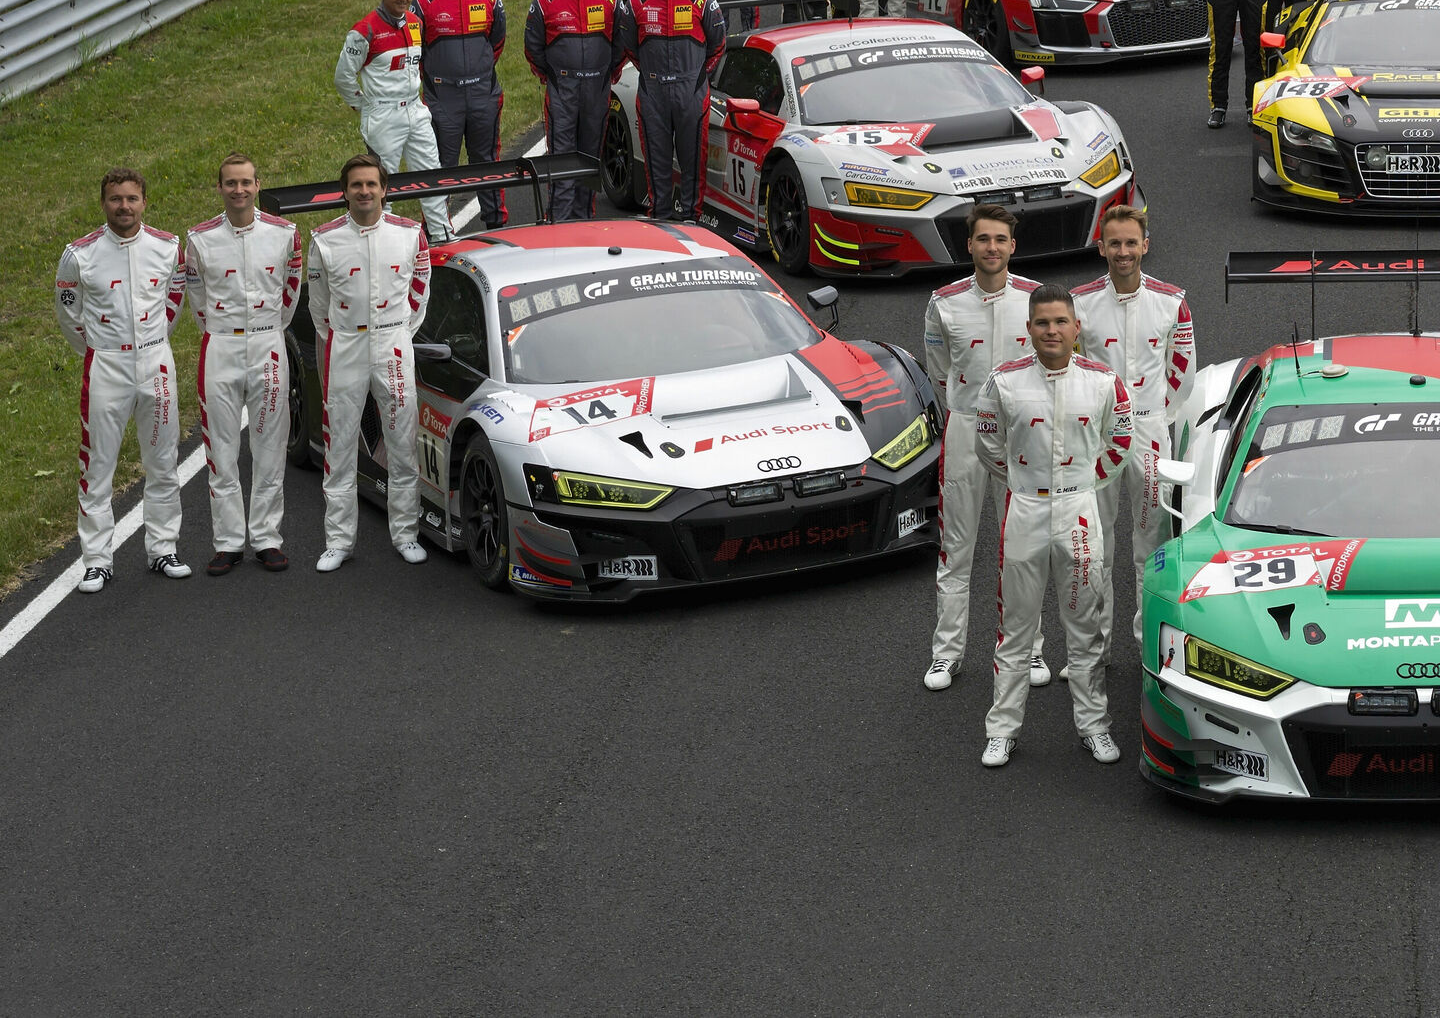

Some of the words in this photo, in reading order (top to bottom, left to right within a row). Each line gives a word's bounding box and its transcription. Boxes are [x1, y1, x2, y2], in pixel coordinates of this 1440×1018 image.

[588, 6, 604, 14] ADAC
[829, 34, 936, 51] CarCollection.de
[892, 47, 928, 58] GRAN
[1021, 52, 1053, 60] DUNLOP
[1276, 81, 1330, 98] 148
[1383, 109, 1430, 118] Giti
[846, 131, 882, 145] 15
[740, 143, 758, 159] TOTAL
[844, 163, 886, 174] RAVENOL
[972, 158, 1025, 171] LUDWIG
[390, 182, 431, 194] udi
[437, 169, 530, 188] Sport
[732, 157, 746, 197] 15
[845, 171, 916, 187] CarCollection.de
[1329, 258, 1425, 272] Audi
[630, 272, 677, 287] GRAN
[711, 279, 759, 287] SIMULATOR
[271, 363, 279, 384] Audi
[387, 360, 397, 402] customer
[395, 360, 405, 381] Audi
[154, 377, 162, 421] customer
[269, 385, 279, 412] Sport
[568, 387, 629, 400] TOTAL
[256, 406, 267, 434] racing
[388, 402, 397, 430] racing
[562, 399, 618, 425] 14
[151, 422, 160, 447] racing
[720, 426, 768, 445] Audi
[772, 419, 833, 440] Sport
[423, 433, 440, 486] 14
[746, 533, 801, 555] Audi
[807, 520, 868, 548] Sport
[1072, 529, 1080, 577] customer
[1258, 546, 1329, 557] TOTAL
[1082, 556, 1090, 586] Sport
[1234, 557, 1297, 588] 29
[1330, 540, 1361, 591] NORDRHEIN
[1068, 578, 1078, 611] racing
[1216, 750, 1246, 770] H&R
[1366, 753, 1433, 773] Audi
